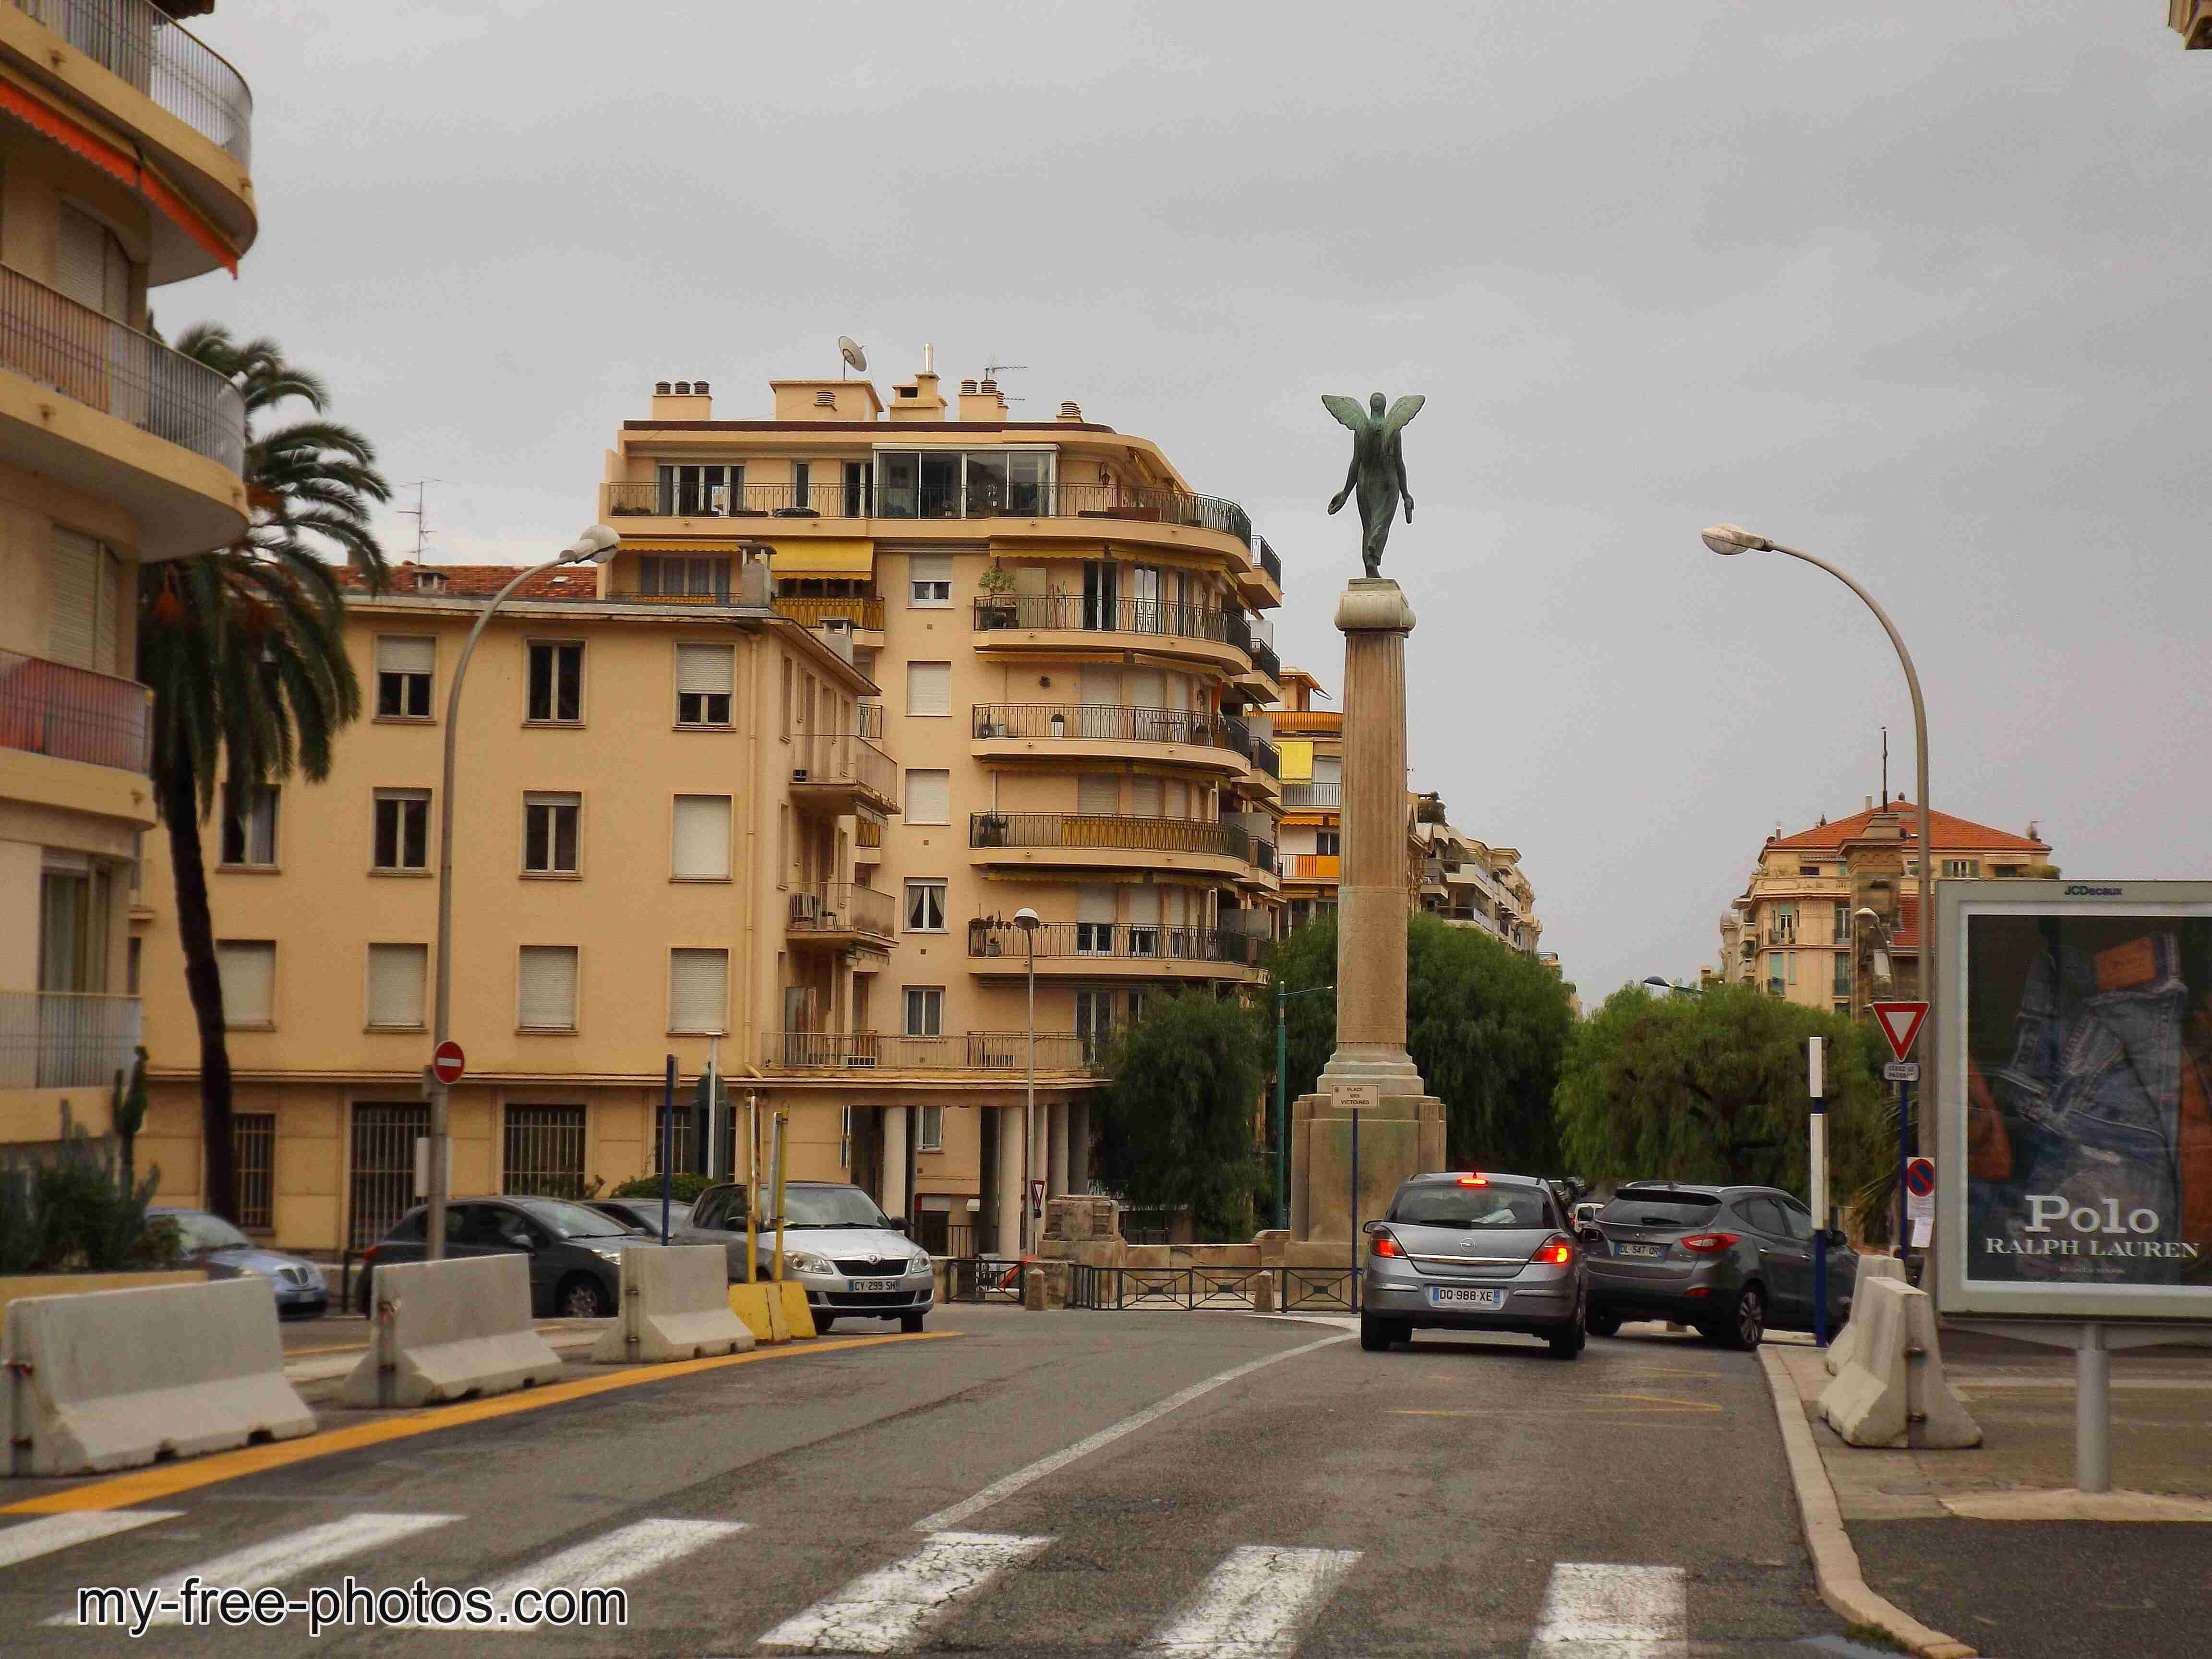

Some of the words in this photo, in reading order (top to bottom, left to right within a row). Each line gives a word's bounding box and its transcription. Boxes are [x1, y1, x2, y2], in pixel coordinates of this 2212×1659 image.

[2064, 885, 2123, 895] JCDecaux
[2024, 1195, 2160, 1234] Polo
[1985, 1238, 2080, 1256] RALPH
[2090, 1240, 2201, 1259] LAUREN
